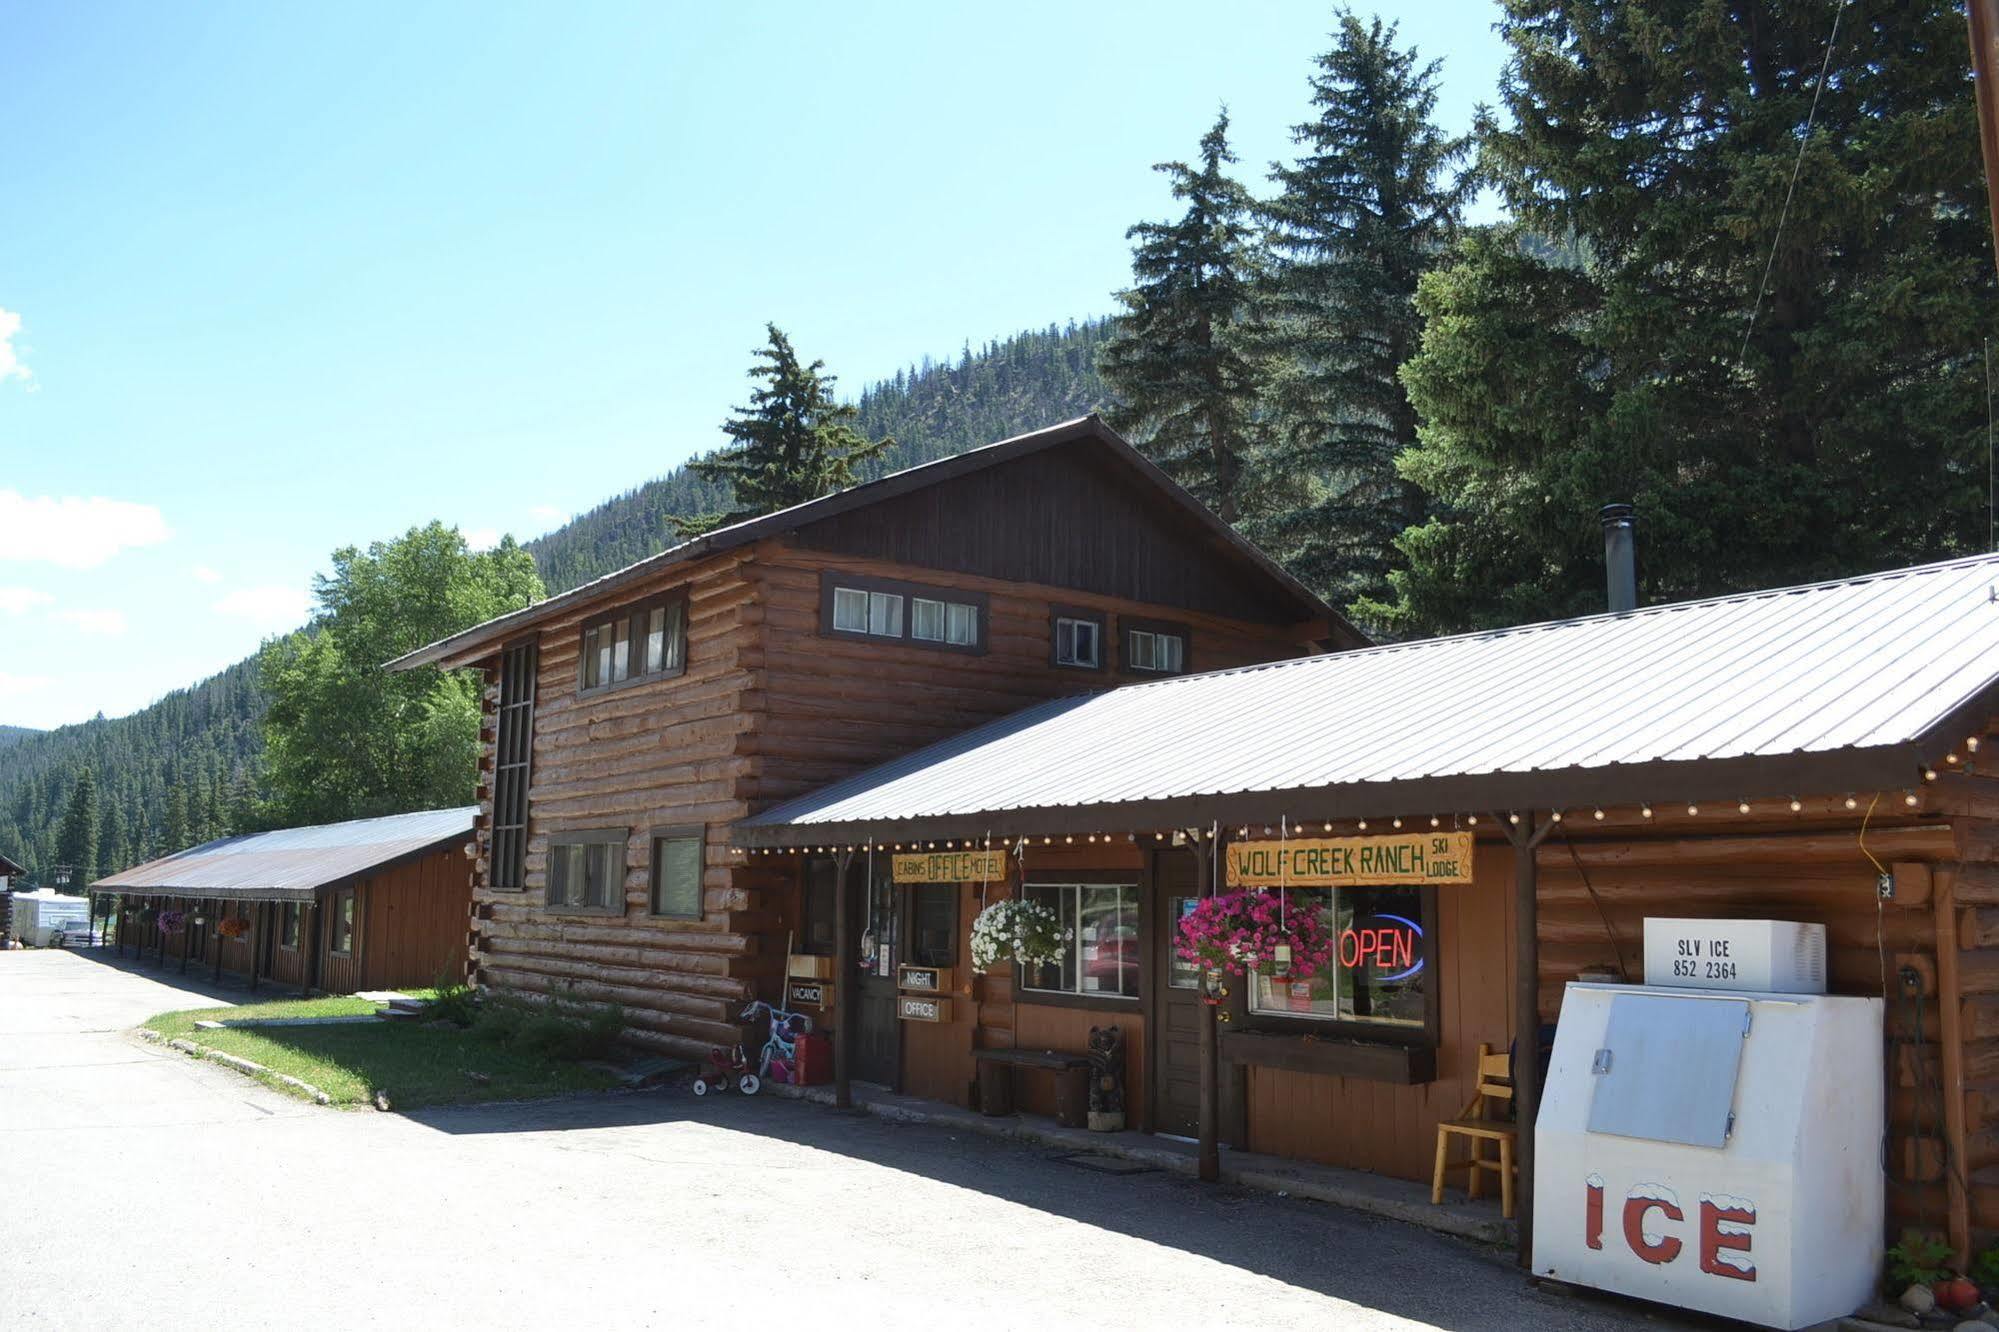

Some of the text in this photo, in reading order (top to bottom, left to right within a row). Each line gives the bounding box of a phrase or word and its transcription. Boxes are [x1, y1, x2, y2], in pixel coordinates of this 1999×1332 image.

[1432, 838, 1449, 855] SKI
[897, 853, 1000, 880] CABINS OFFICE MOTEL
[1238, 845, 1425, 877] WOLF CREEK RANCH
[1426, 860, 1459, 878] LODGE
[1339, 929, 1413, 968] OPEN
[1678, 939, 1730, 957] SLV ICE
[906, 971, 931, 986] NIGHT
[1673, 960, 1737, 979] 852 2364
[791, 987, 822, 1001] VACANCY
[904, 1001, 934, 1017] OFFICE
[1585, 1173, 1757, 1282] ICE
